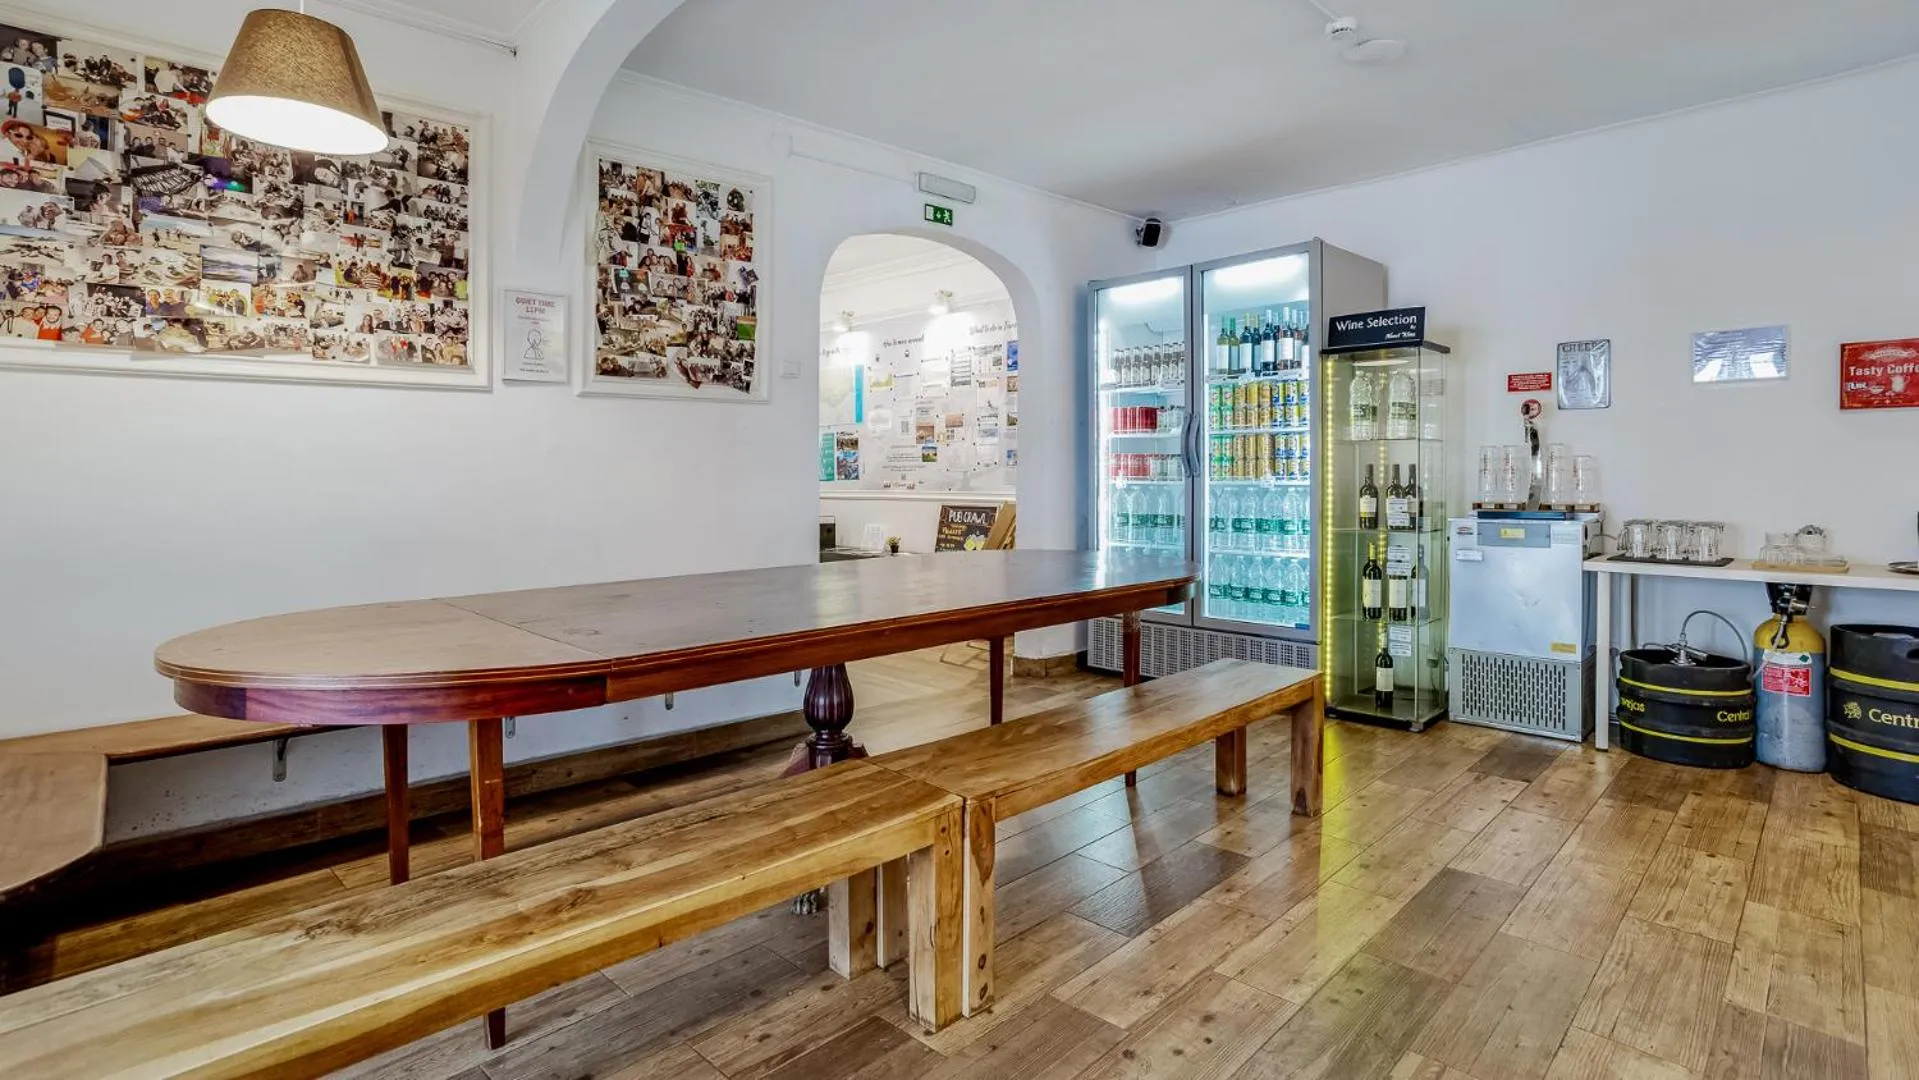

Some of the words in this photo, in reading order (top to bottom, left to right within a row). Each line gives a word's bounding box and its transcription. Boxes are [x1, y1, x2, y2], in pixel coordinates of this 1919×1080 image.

[1335, 319, 1364, 332] Wine
[1366, 314, 1417, 328] Selection
[1562, 342, 1606, 353] CHEER
[1849, 366, 1884, 377] Tasty
[948, 510, 963, 523] PUB
